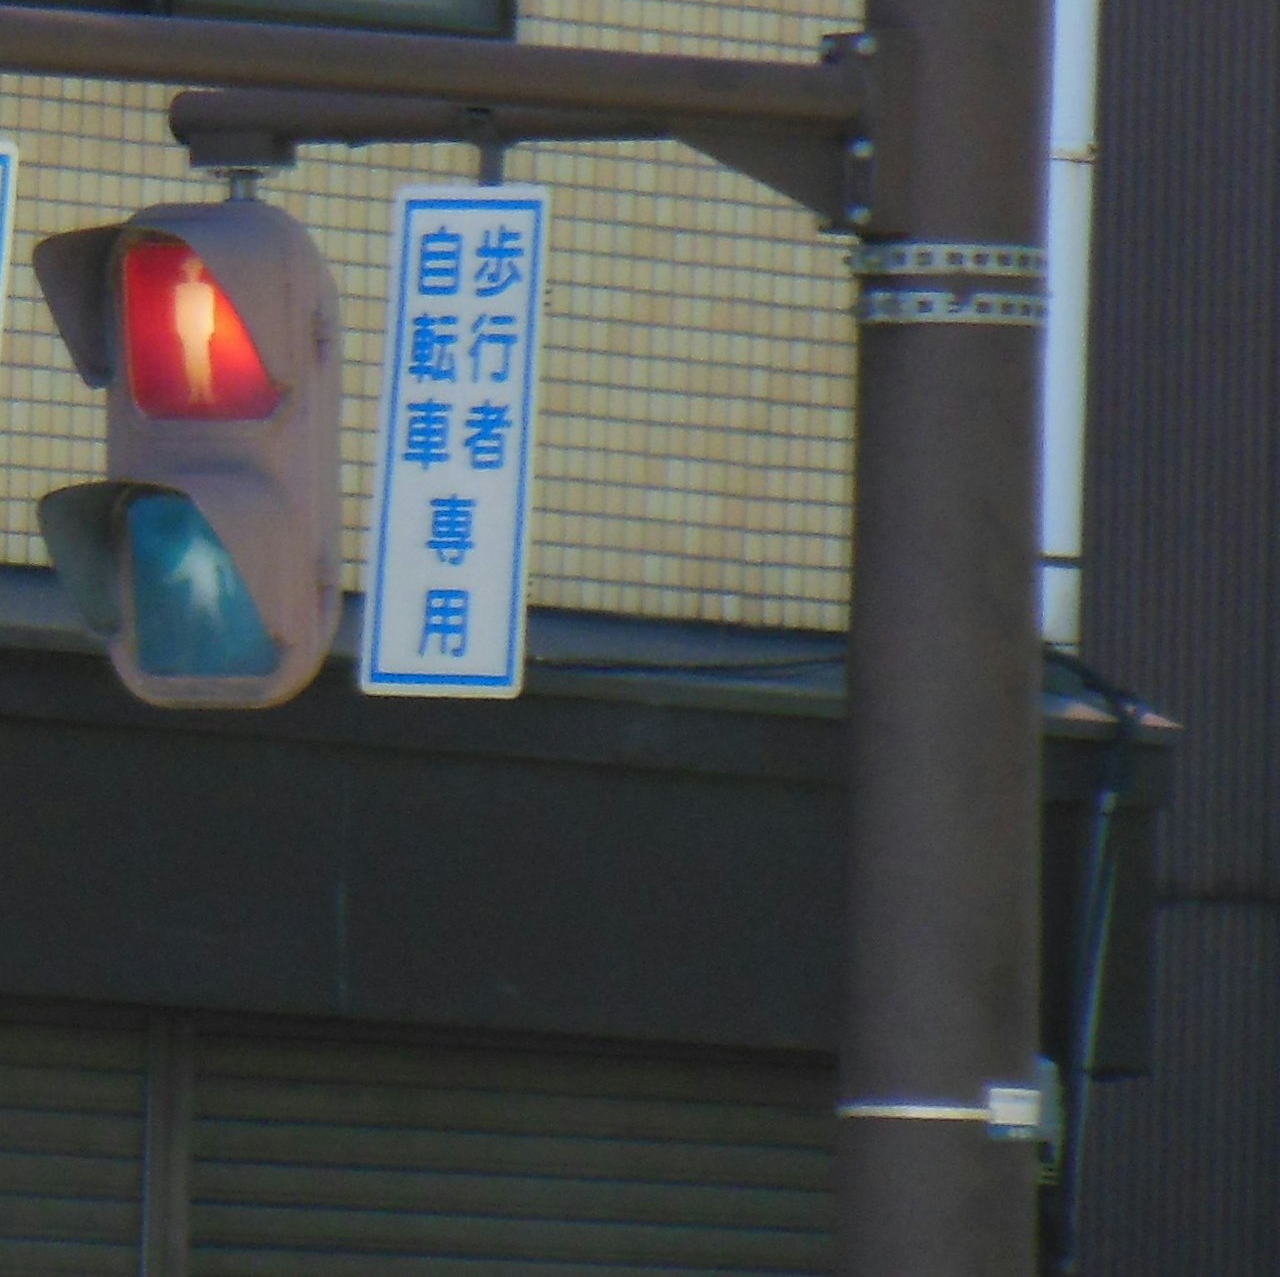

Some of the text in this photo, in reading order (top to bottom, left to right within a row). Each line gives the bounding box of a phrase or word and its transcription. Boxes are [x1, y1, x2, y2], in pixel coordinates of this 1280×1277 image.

[401, 225, 462, 471] 自転車
[464, 224, 525, 472] 歩行者
[418, 493, 476, 659] 専用
